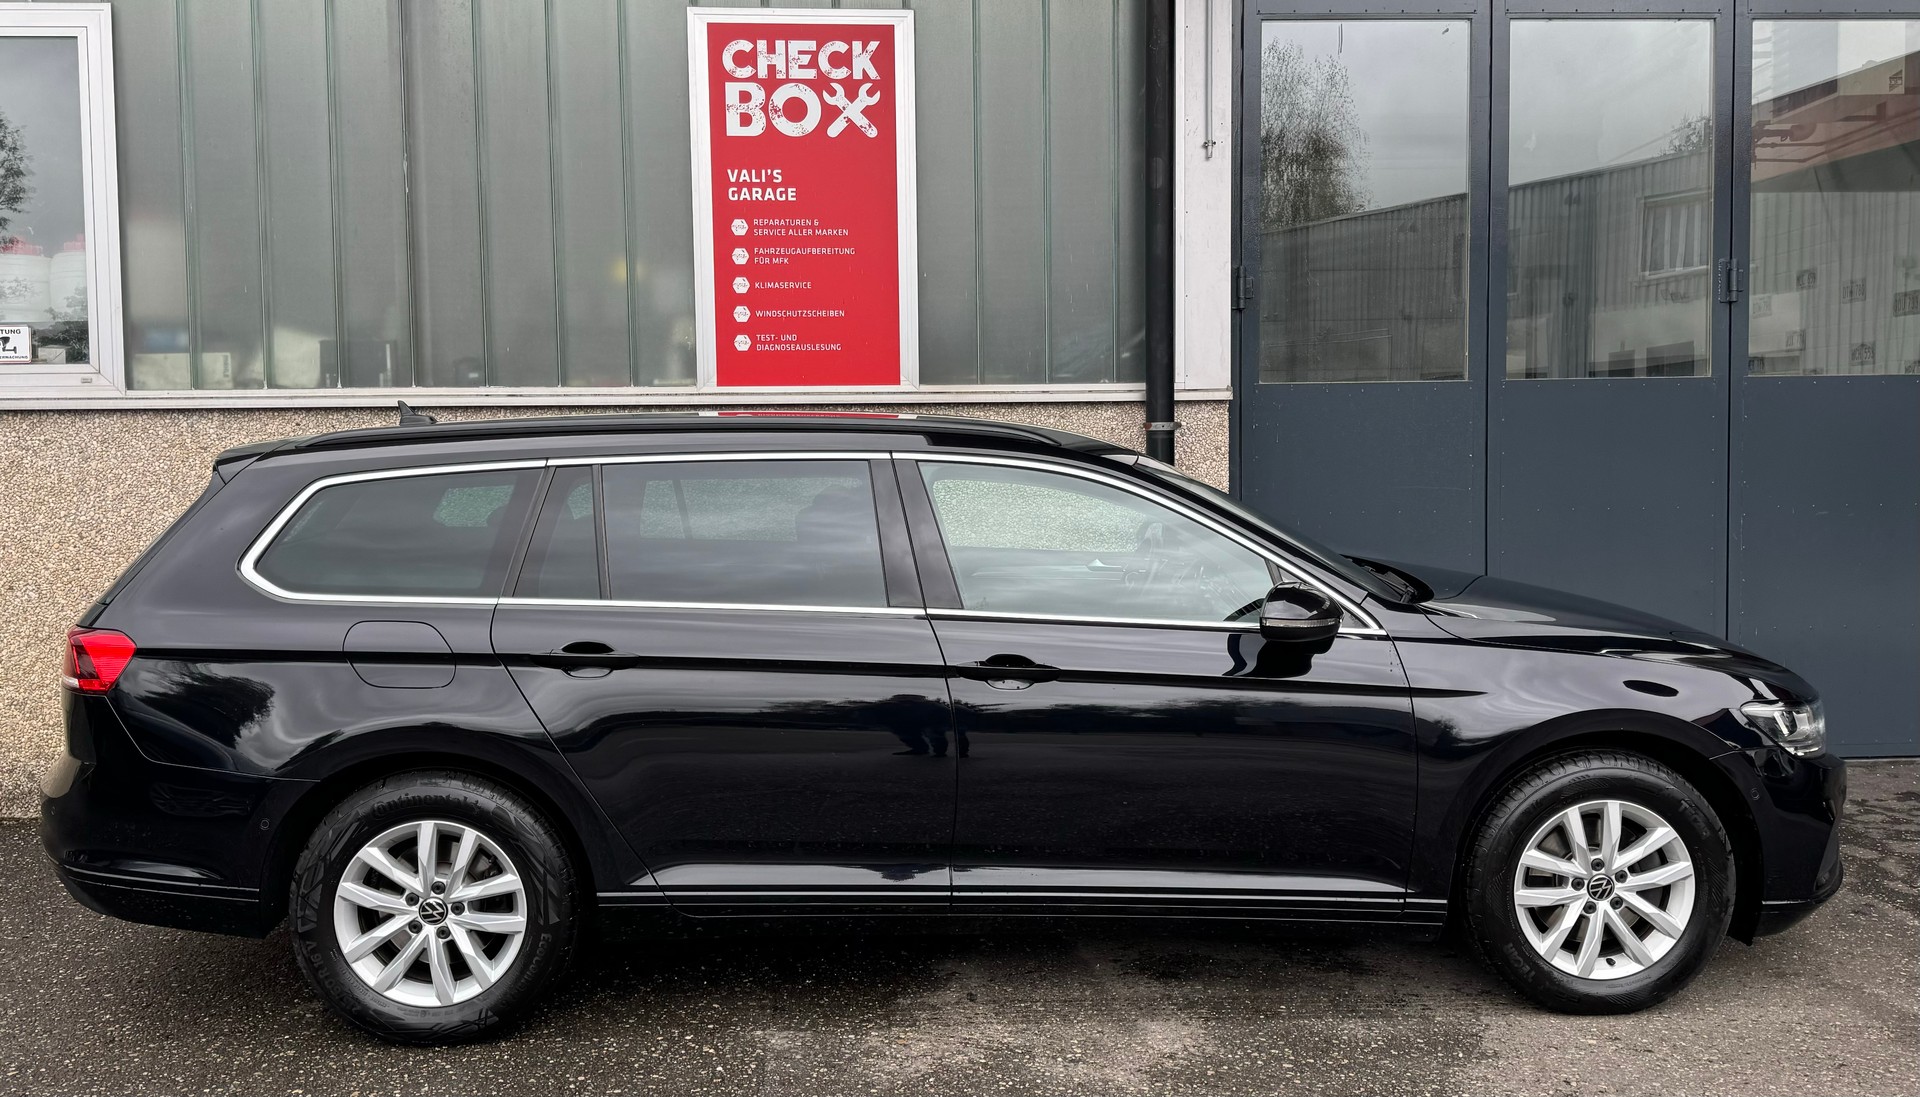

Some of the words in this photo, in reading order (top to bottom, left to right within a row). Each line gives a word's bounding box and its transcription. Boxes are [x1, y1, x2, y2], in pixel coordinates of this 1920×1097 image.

[722, 40, 880, 80] CHECK
[725, 82, 880, 138] BOX
[727, 169, 783, 183] VALI'S
[728, 187, 797, 201] GARAGE
[753, 228, 787, 236] SERVICE
[754, 247, 856, 255] FAHRZEUGAUFBEREITUNG
[754, 256, 771, 265] FÜR
[772, 257, 789, 265] MFK
[754, 281, 812, 289] KLIMASERVICE
[755, 310, 845, 318] WINDSCHUTZSCHEIBEN
[756, 334, 778, 342] TEST-
[780, 334, 798, 342] UND
[756, 343, 842, 351] DIAGNOSEAUSLESUNG
